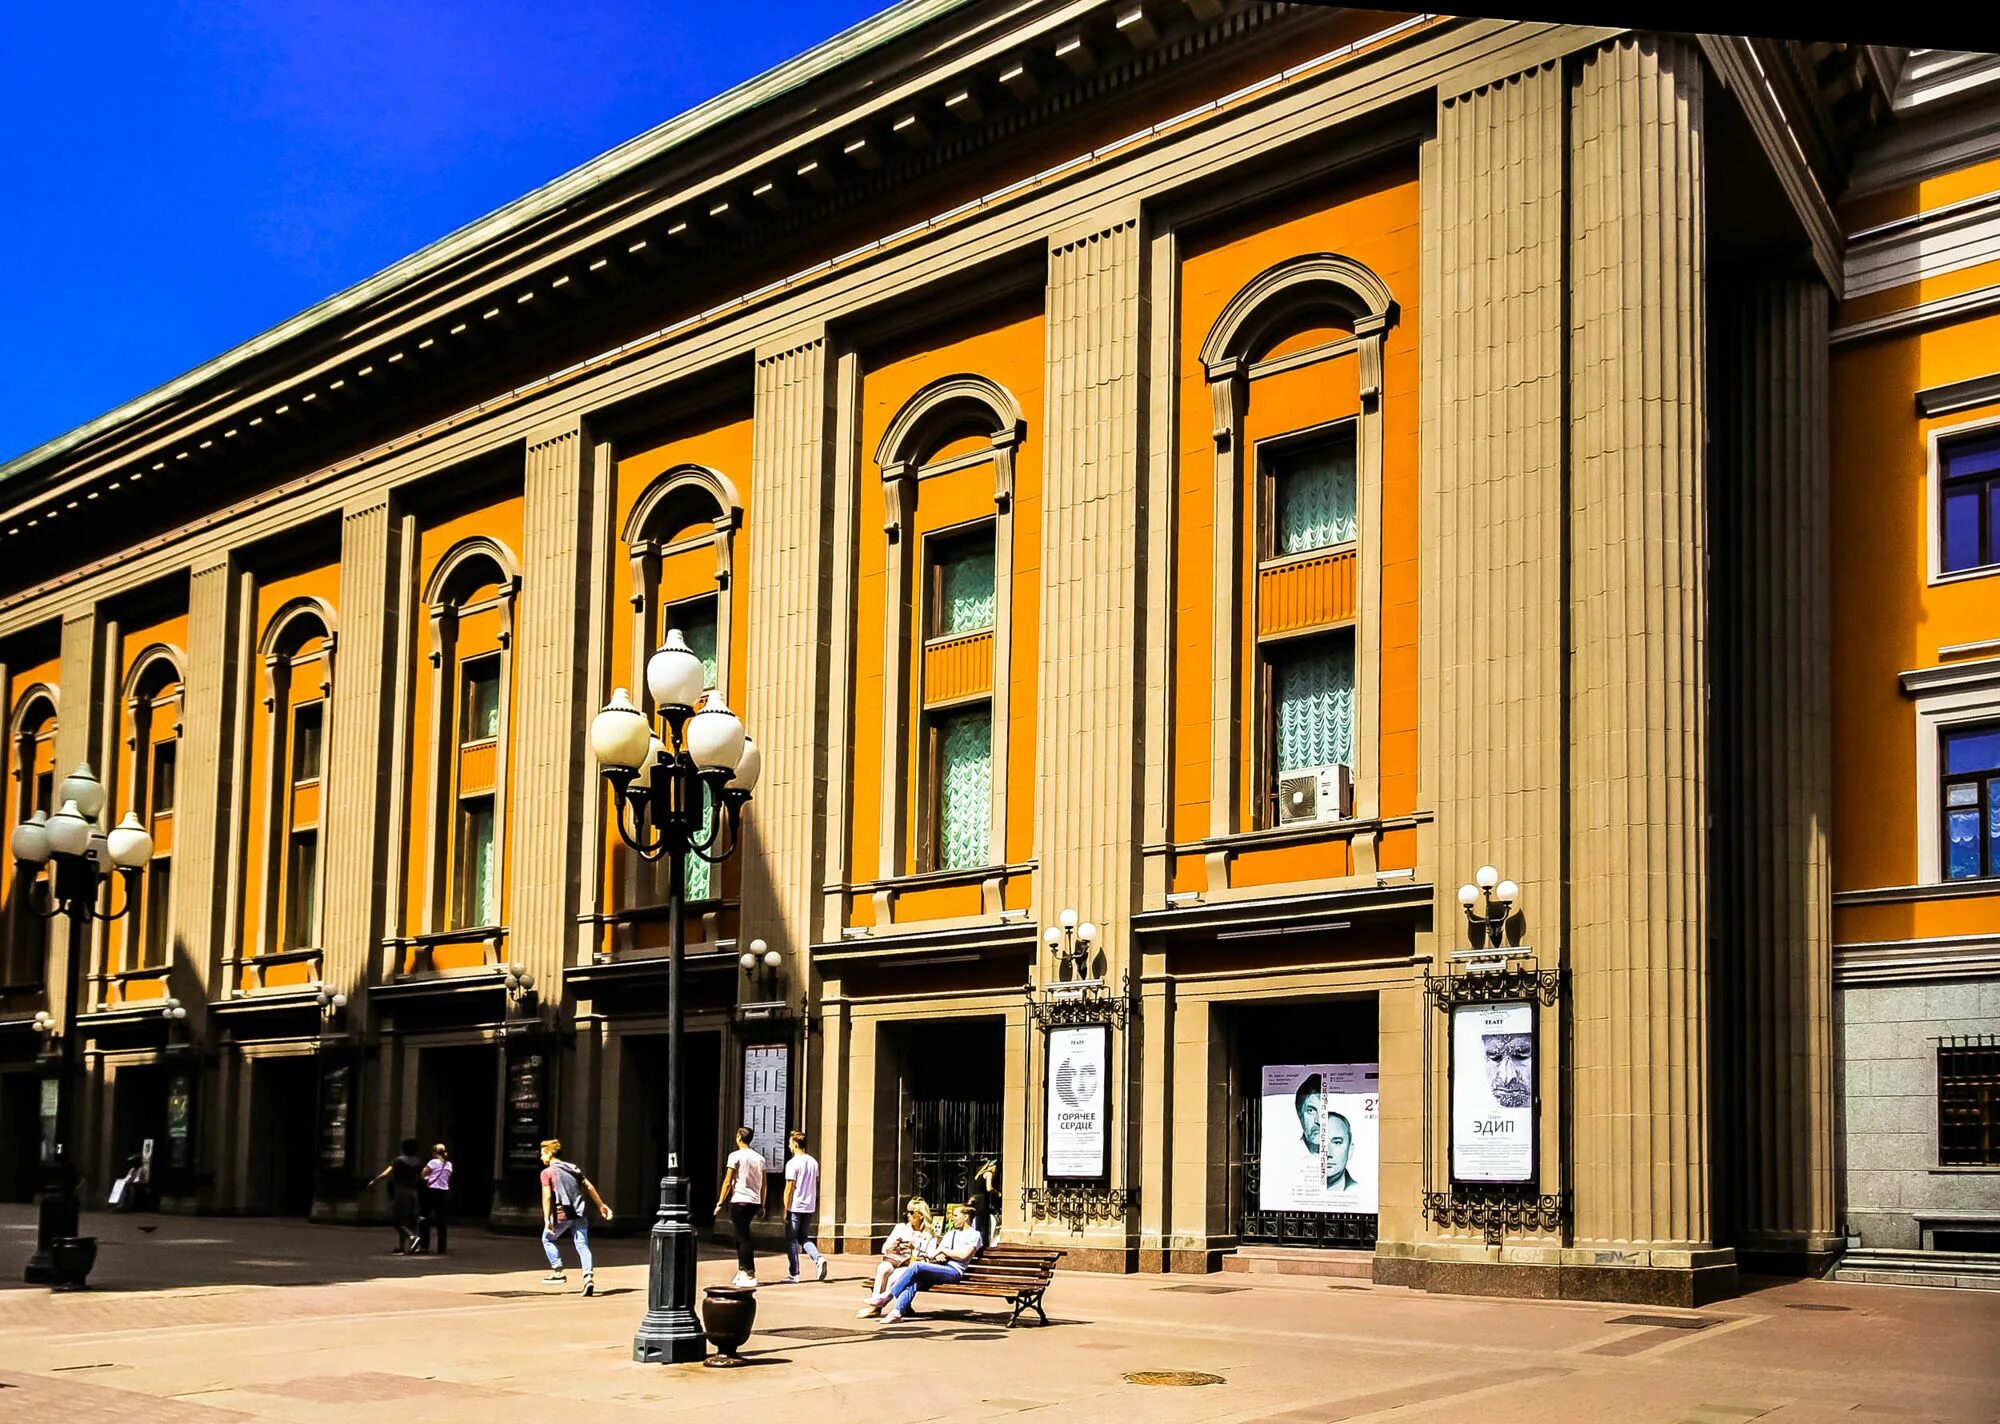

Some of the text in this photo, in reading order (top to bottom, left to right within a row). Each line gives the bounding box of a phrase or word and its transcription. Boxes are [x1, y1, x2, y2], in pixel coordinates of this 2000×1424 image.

[1057, 1112, 1096, 1121] ГОРЯЧЕЕ
[1060, 1121, 1094, 1131] СЕРДЦЕ
[1473, 1120, 1515, 1136] ЭДИП
